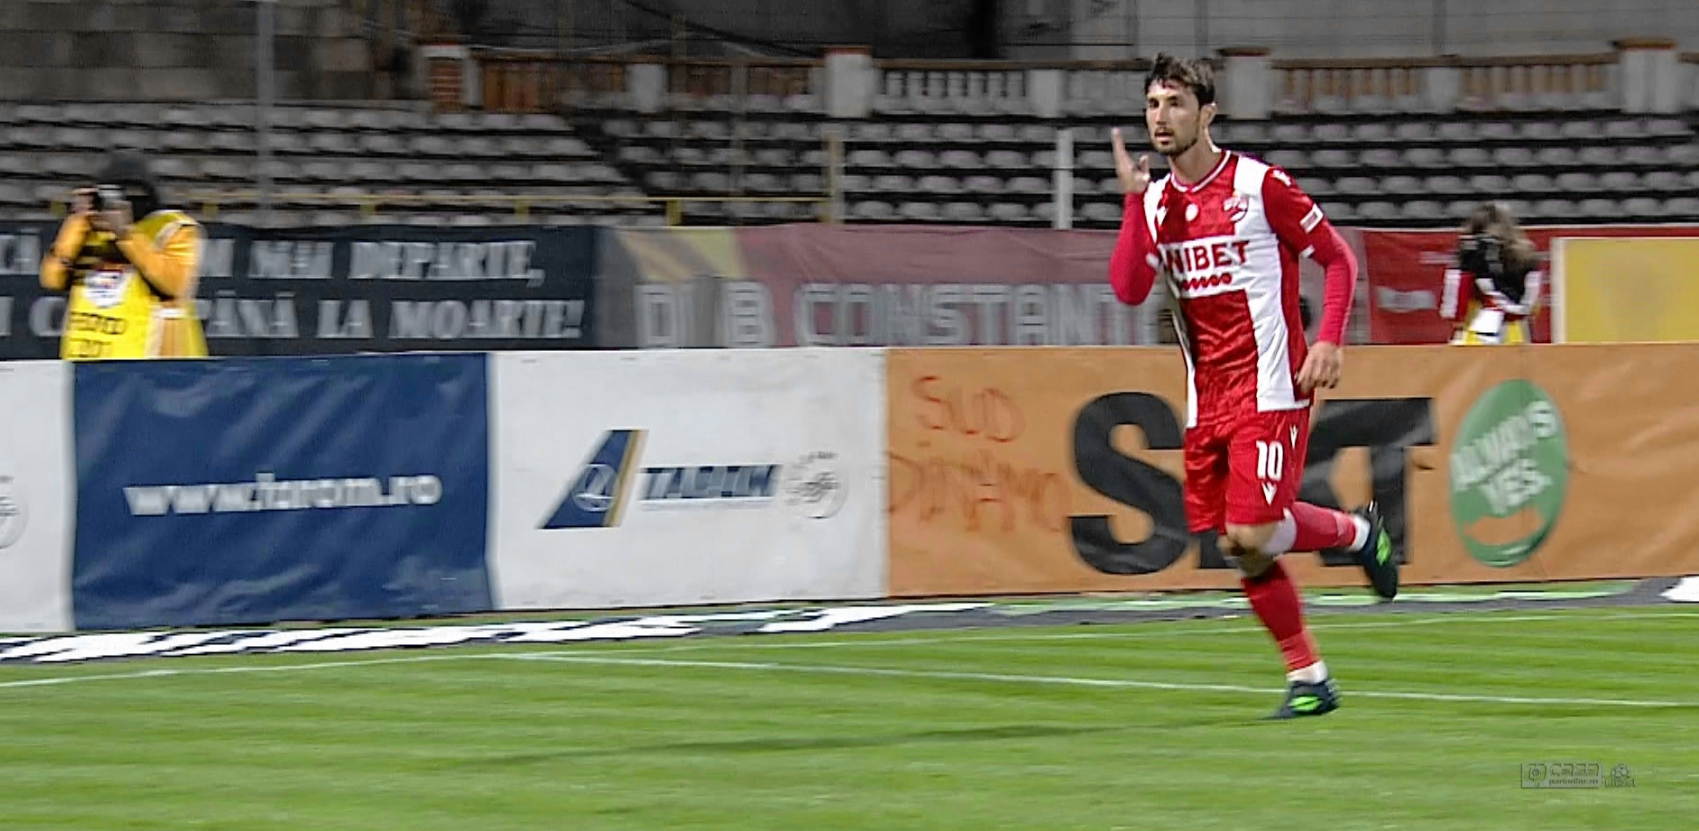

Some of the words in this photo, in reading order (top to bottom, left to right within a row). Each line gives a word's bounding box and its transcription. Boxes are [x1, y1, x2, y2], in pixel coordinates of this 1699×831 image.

[1160, 239, 1251, 276] NIBET
[315, 299, 375, 339] LA
[388, 299, 584, 340] MOARTE!
[1255, 439, 1284, 482] 10
[1069, 391, 1436, 576] SXT
